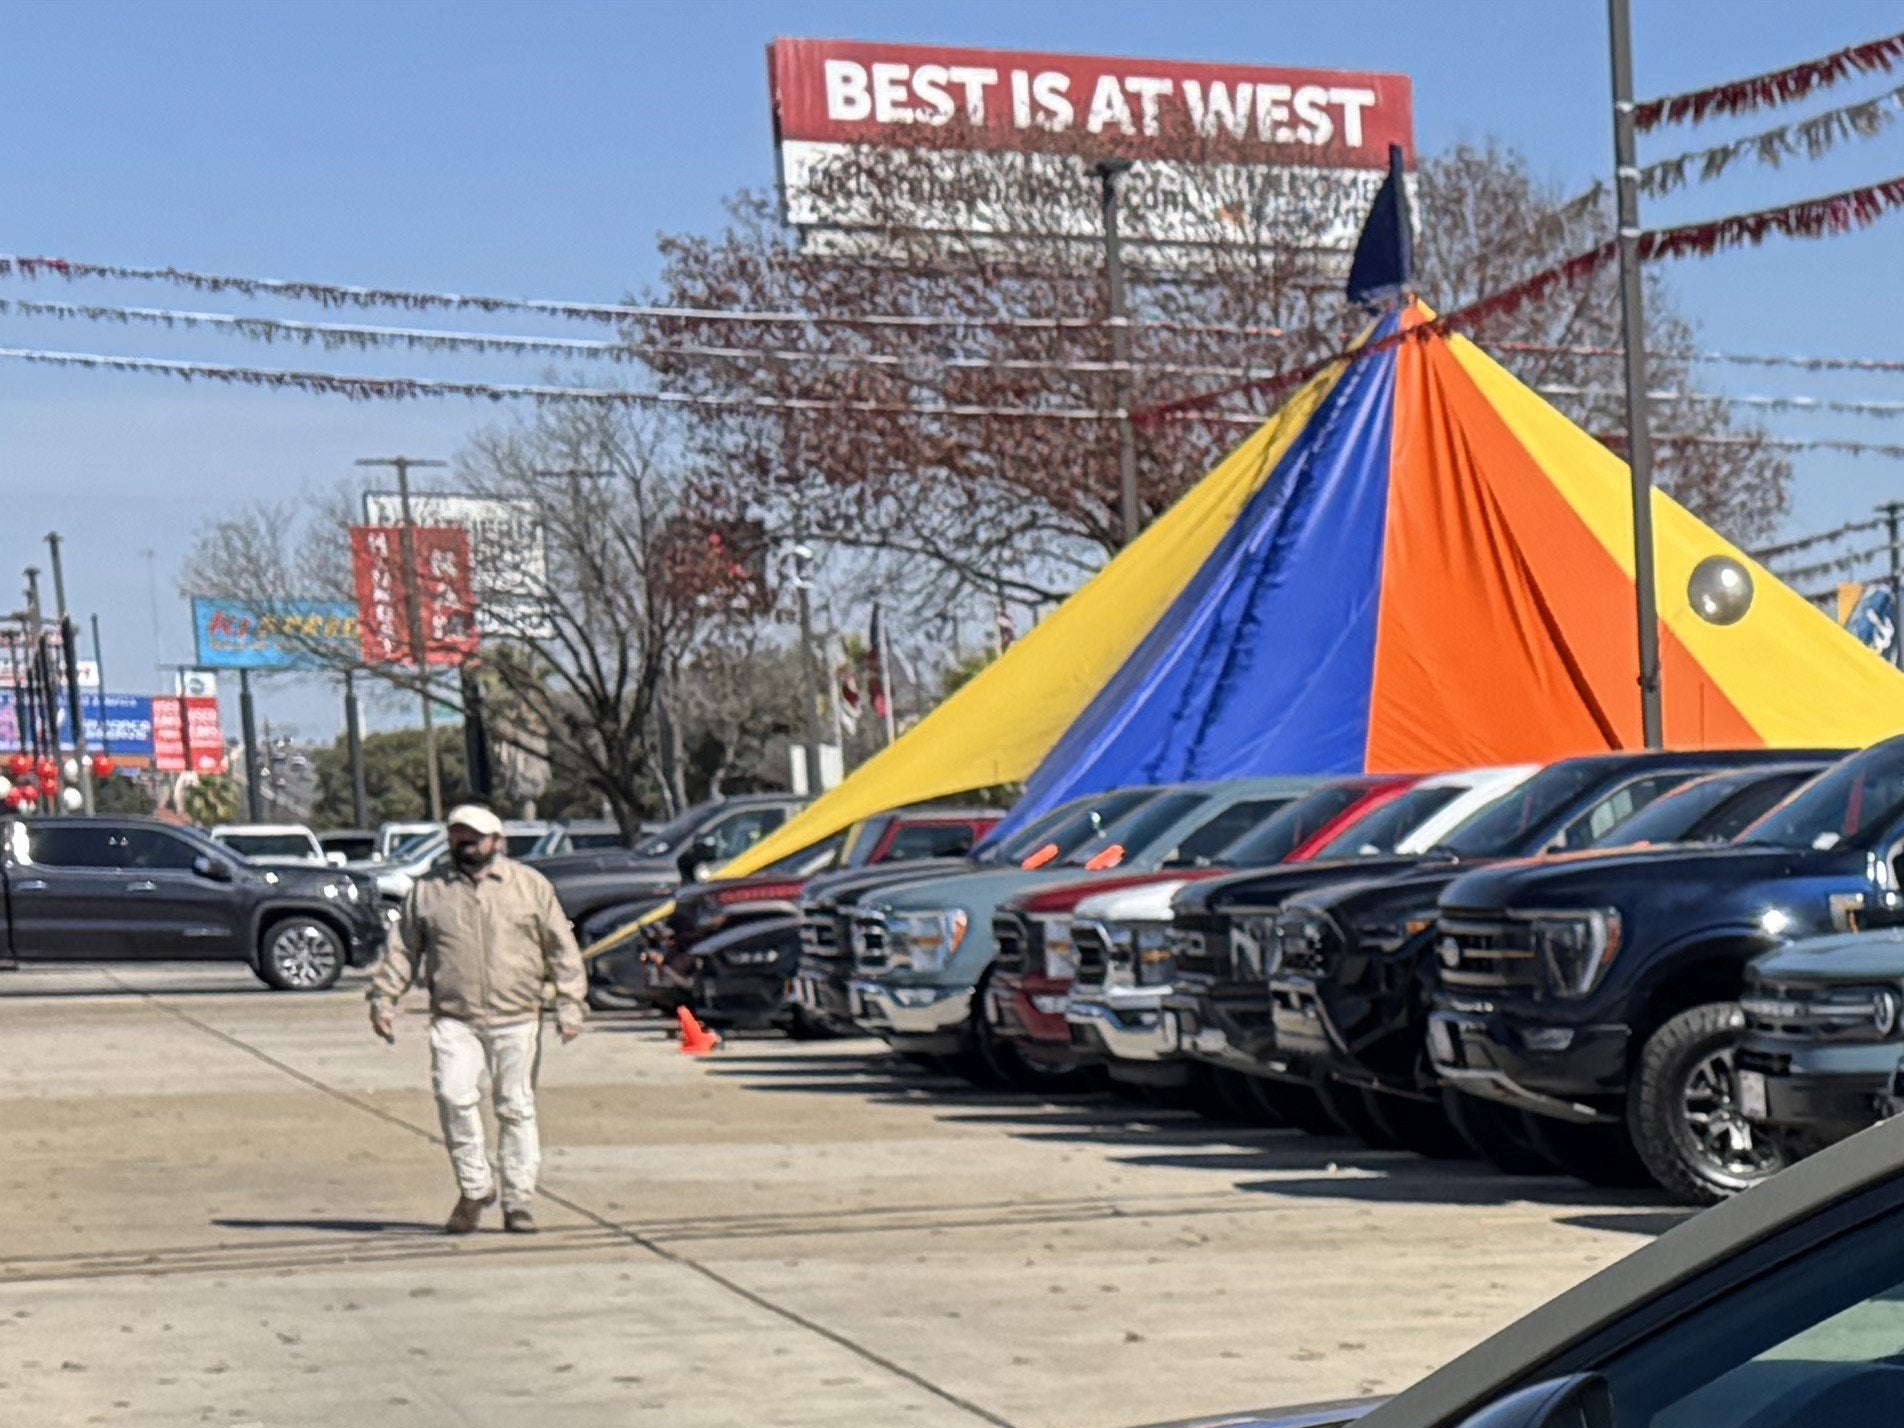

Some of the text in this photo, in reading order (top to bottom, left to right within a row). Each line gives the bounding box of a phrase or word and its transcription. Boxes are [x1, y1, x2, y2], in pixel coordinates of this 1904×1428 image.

[824, 59, 1376, 148] BEST IS AT WEST
